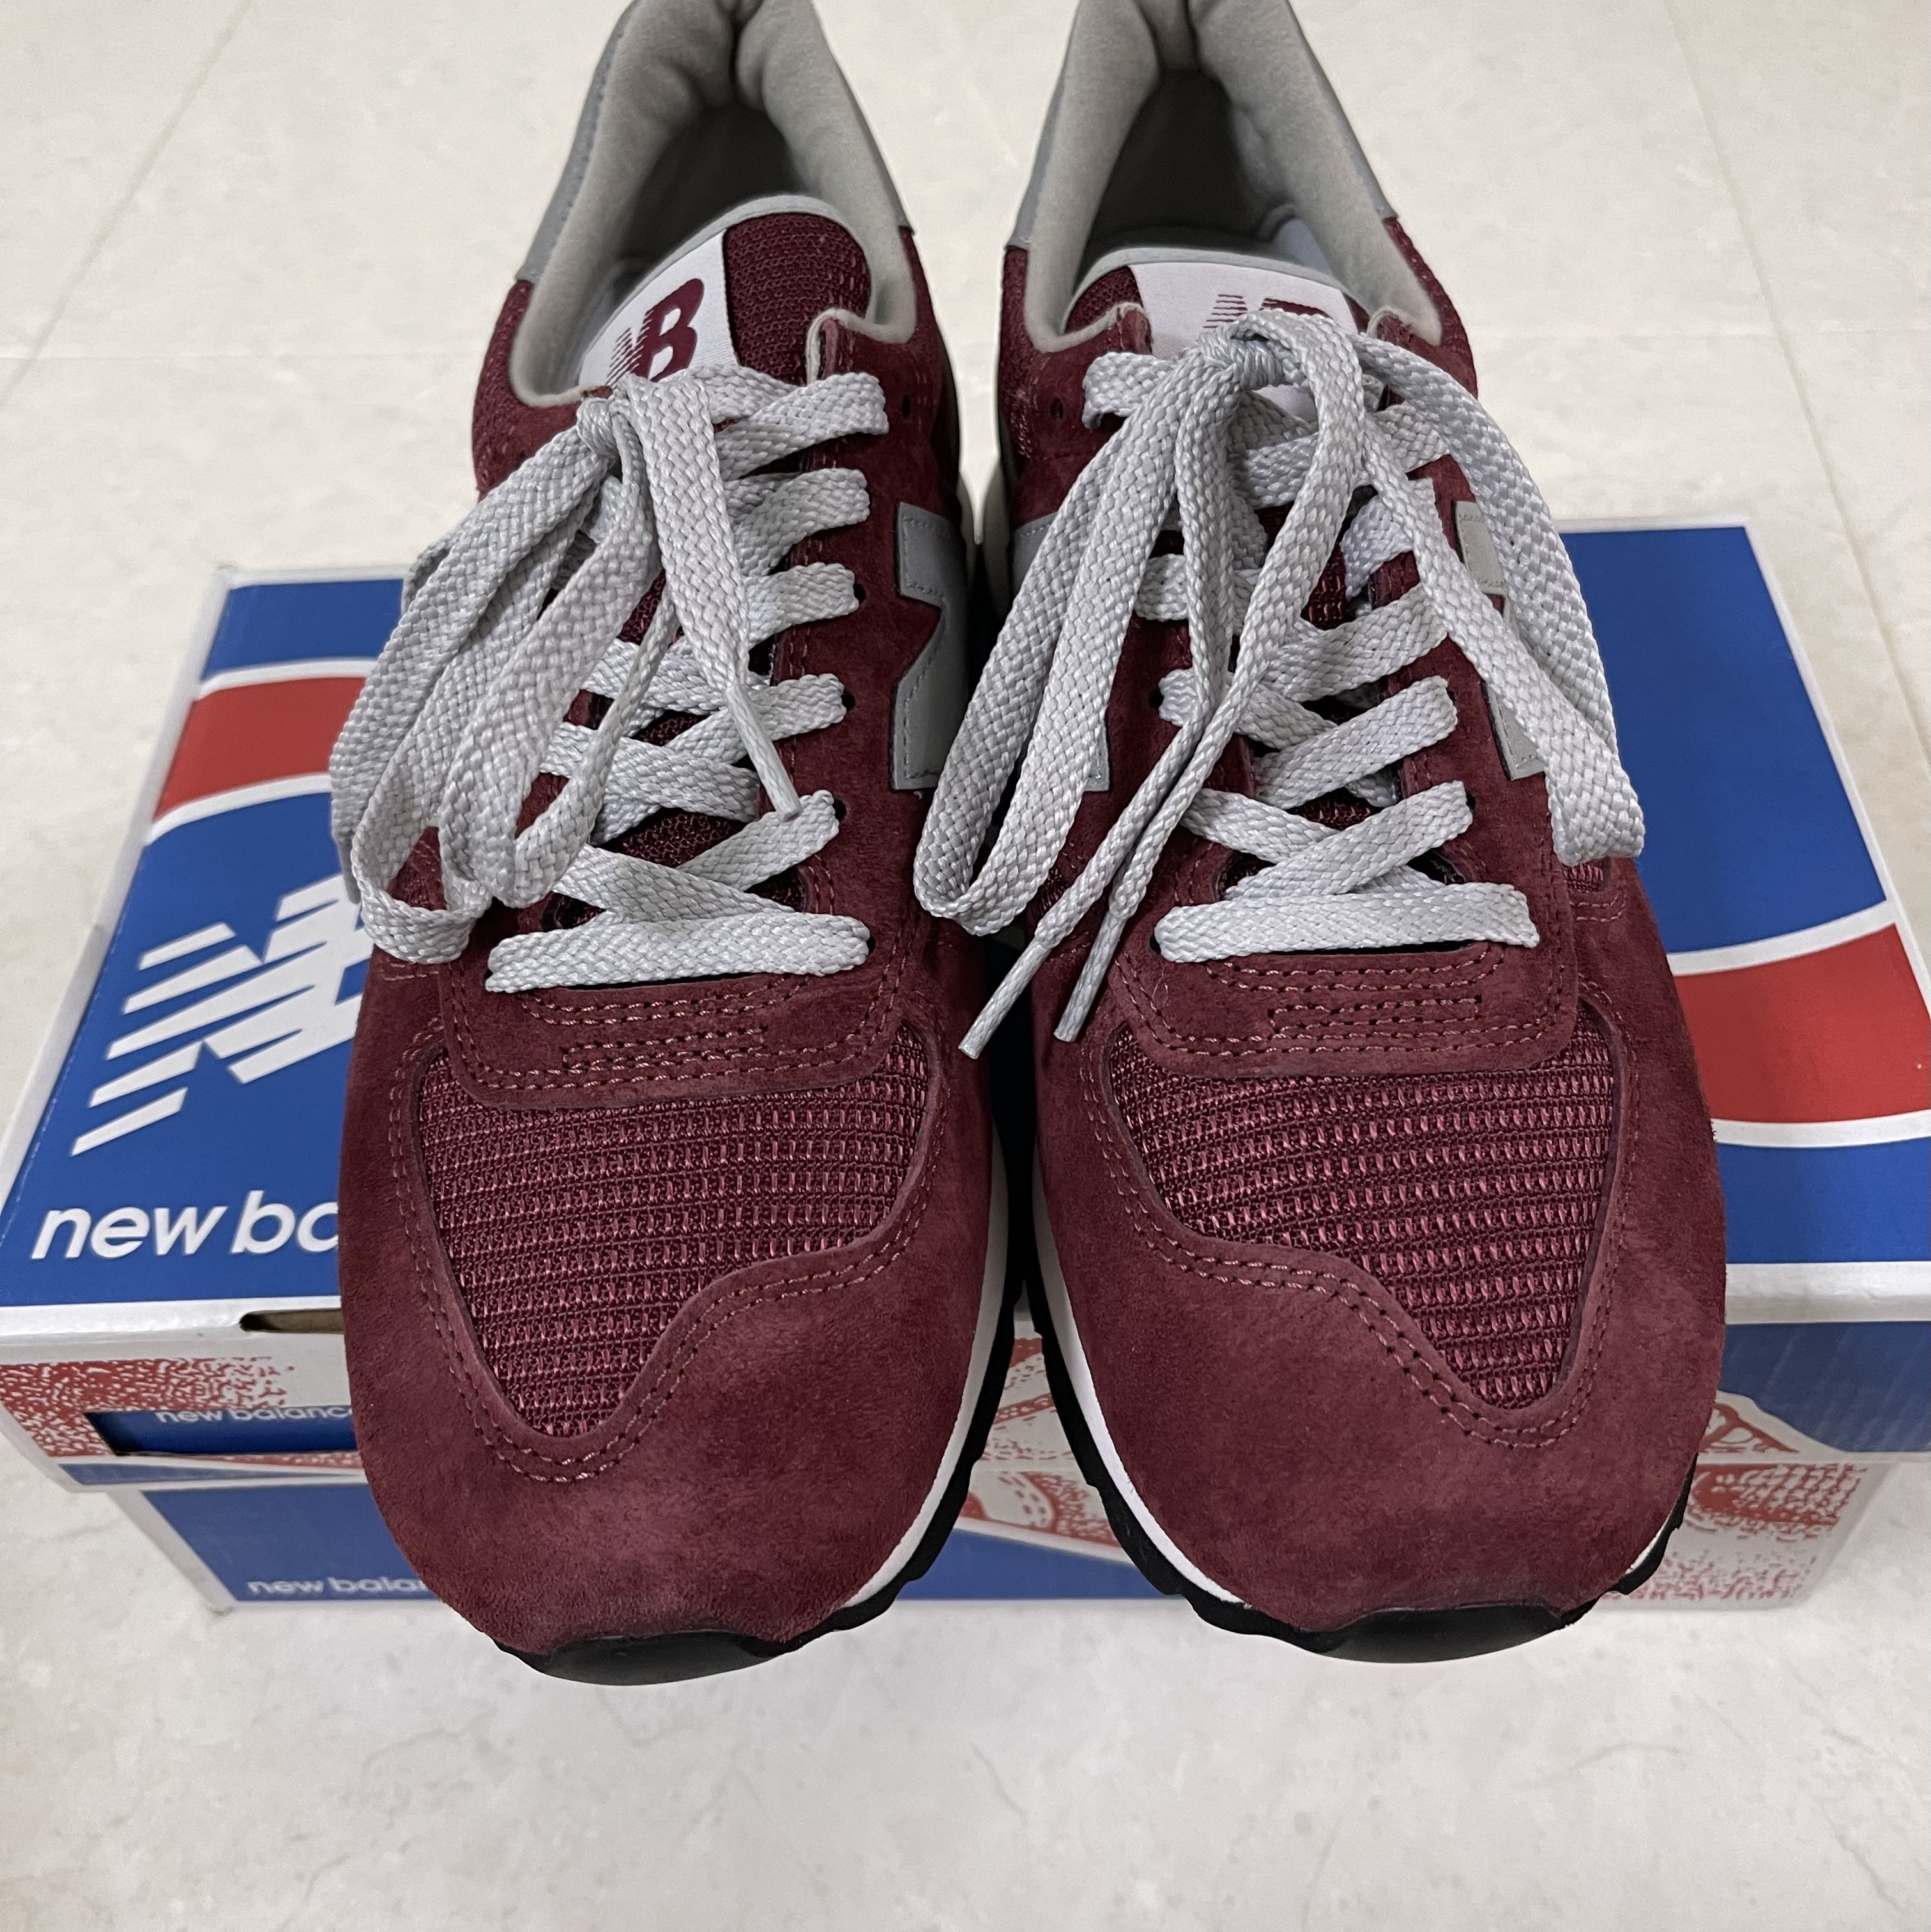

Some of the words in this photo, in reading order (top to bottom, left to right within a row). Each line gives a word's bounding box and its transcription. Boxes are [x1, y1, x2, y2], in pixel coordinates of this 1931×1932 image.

[31, 1207, 229, 1259] new
[155, 1410, 223, 1423] new
[228, 1407, 353, 1420] balanc
[247, 1580, 324, 1594] new
